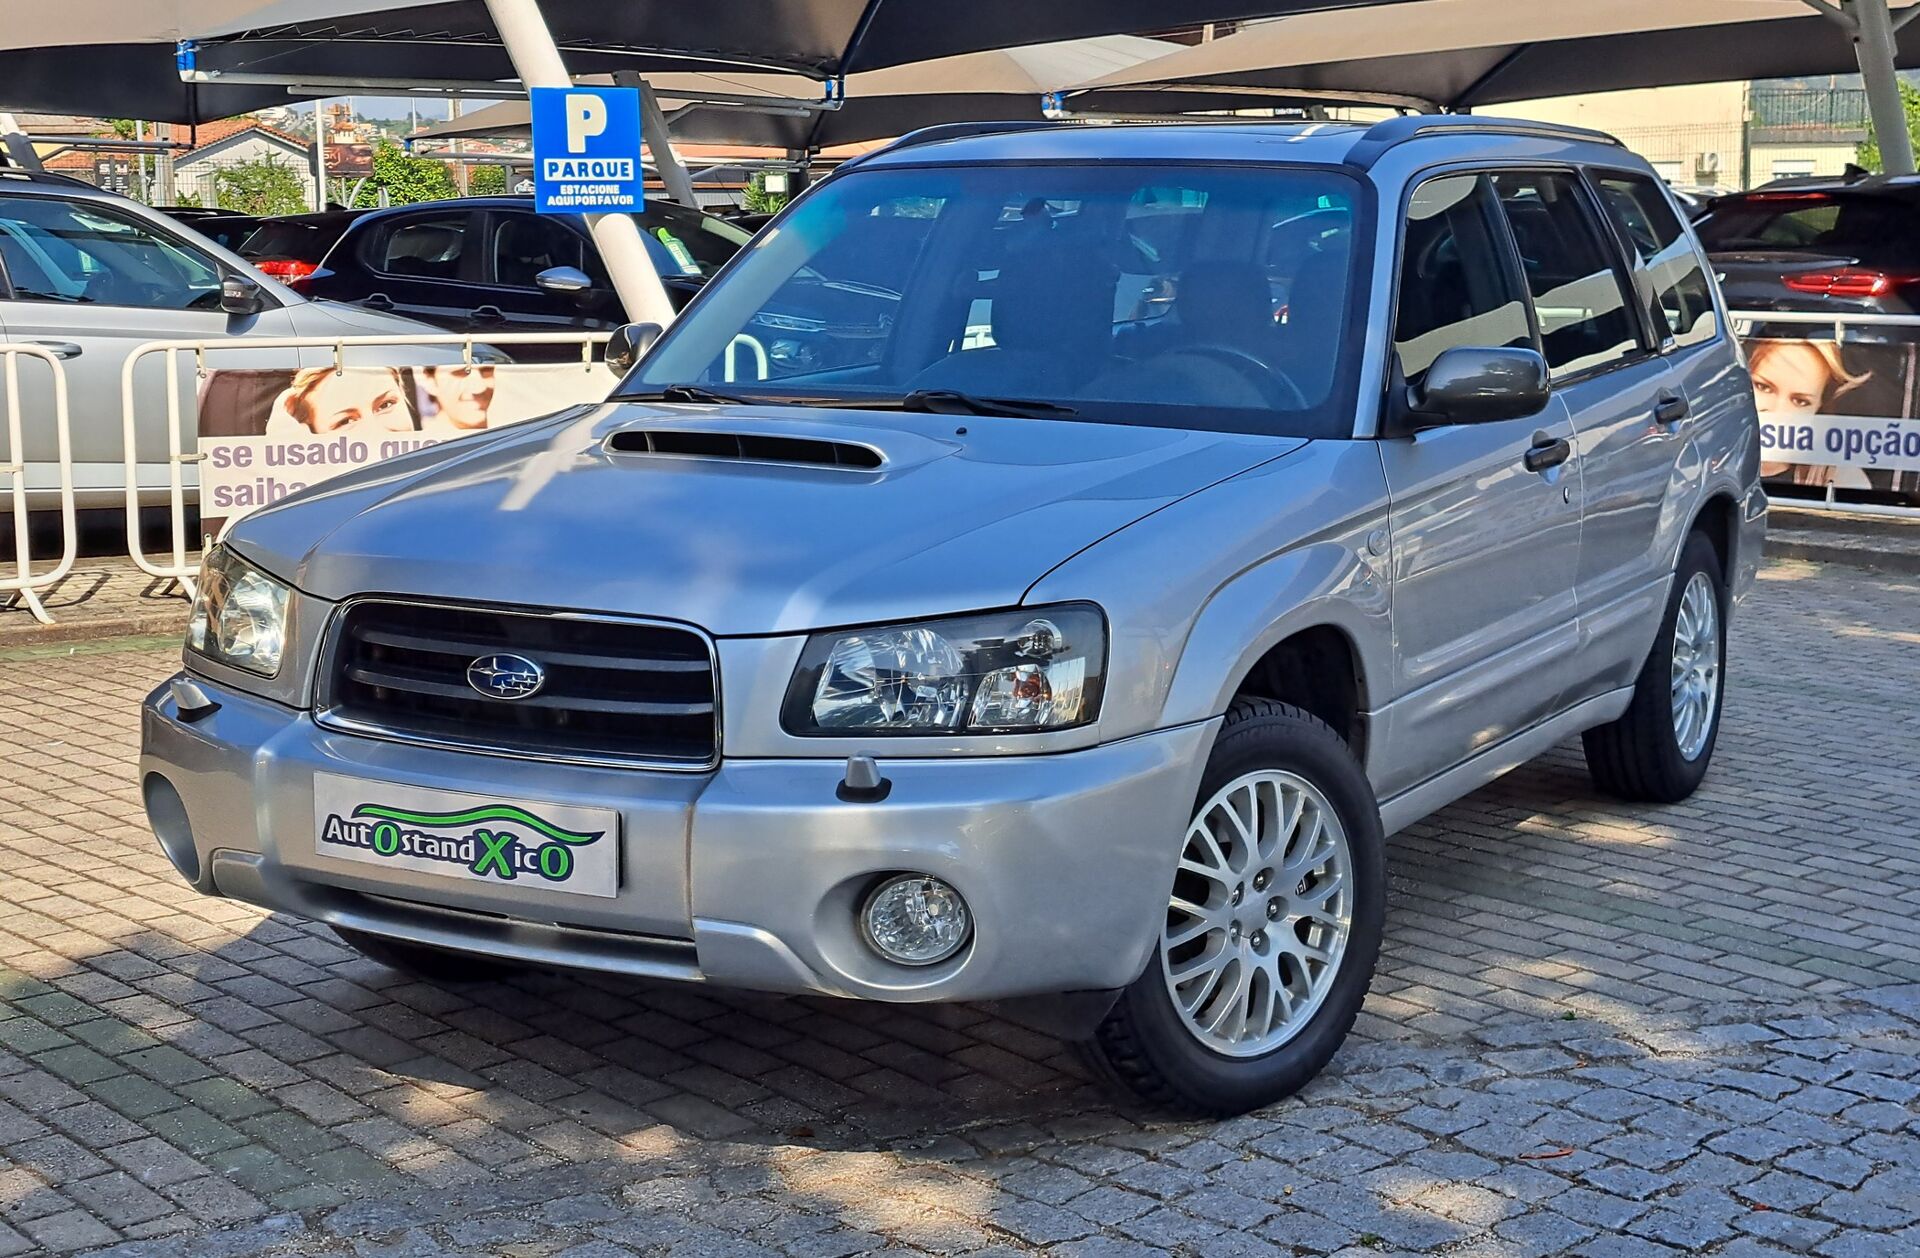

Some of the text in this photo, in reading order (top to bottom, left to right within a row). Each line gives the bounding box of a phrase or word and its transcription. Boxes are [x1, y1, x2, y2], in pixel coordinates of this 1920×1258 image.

[565, 93, 607, 153] P
[547, 162, 630, 178] PARQUE
[560, 184, 620, 195] ESTACIONE
[212, 444, 253, 469] se
[265, 436, 369, 467] usado
[1760, 422, 1920, 464] sua opção
